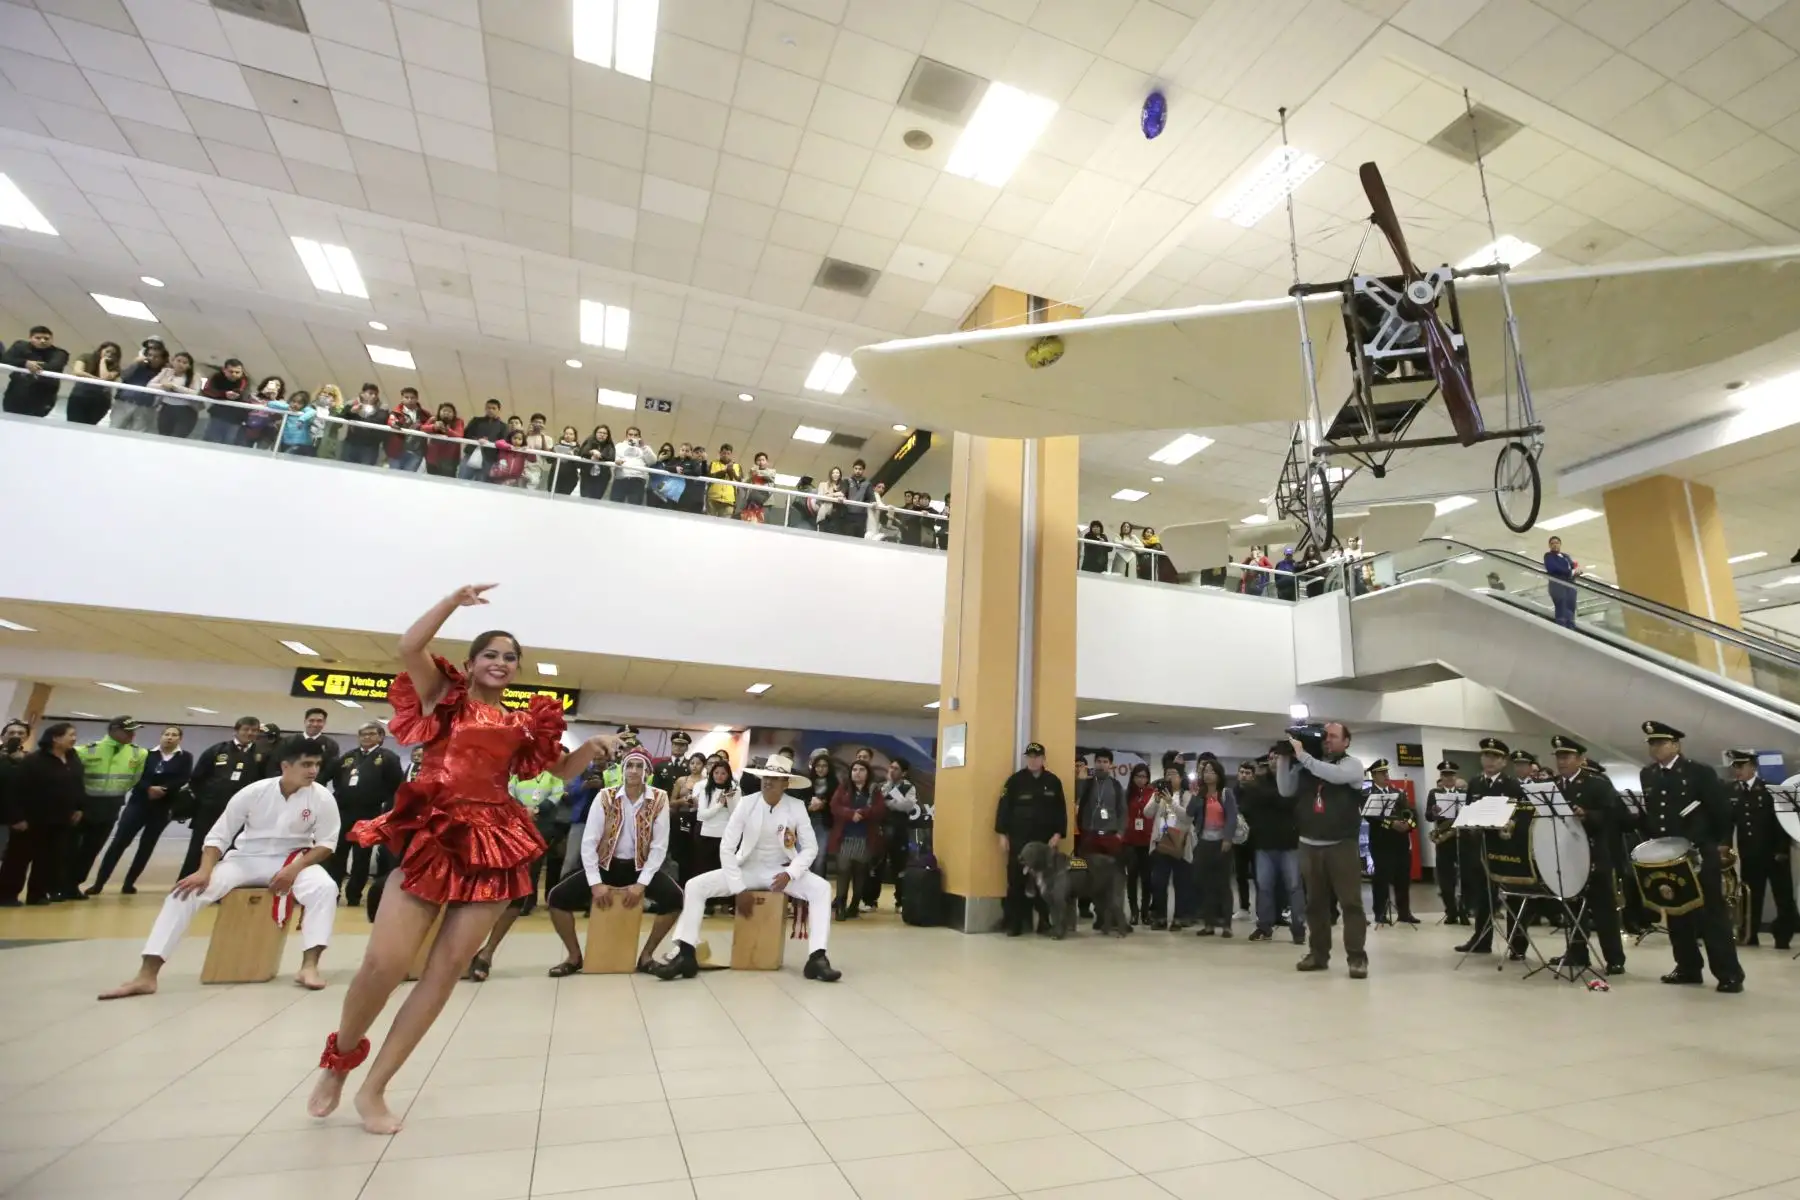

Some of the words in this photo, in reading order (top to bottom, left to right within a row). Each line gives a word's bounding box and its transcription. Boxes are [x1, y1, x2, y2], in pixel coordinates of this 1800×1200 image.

[352, 676, 375, 687] Venta
[376, 679, 388, 688] de
[350, 688, 369, 696] Ticket
